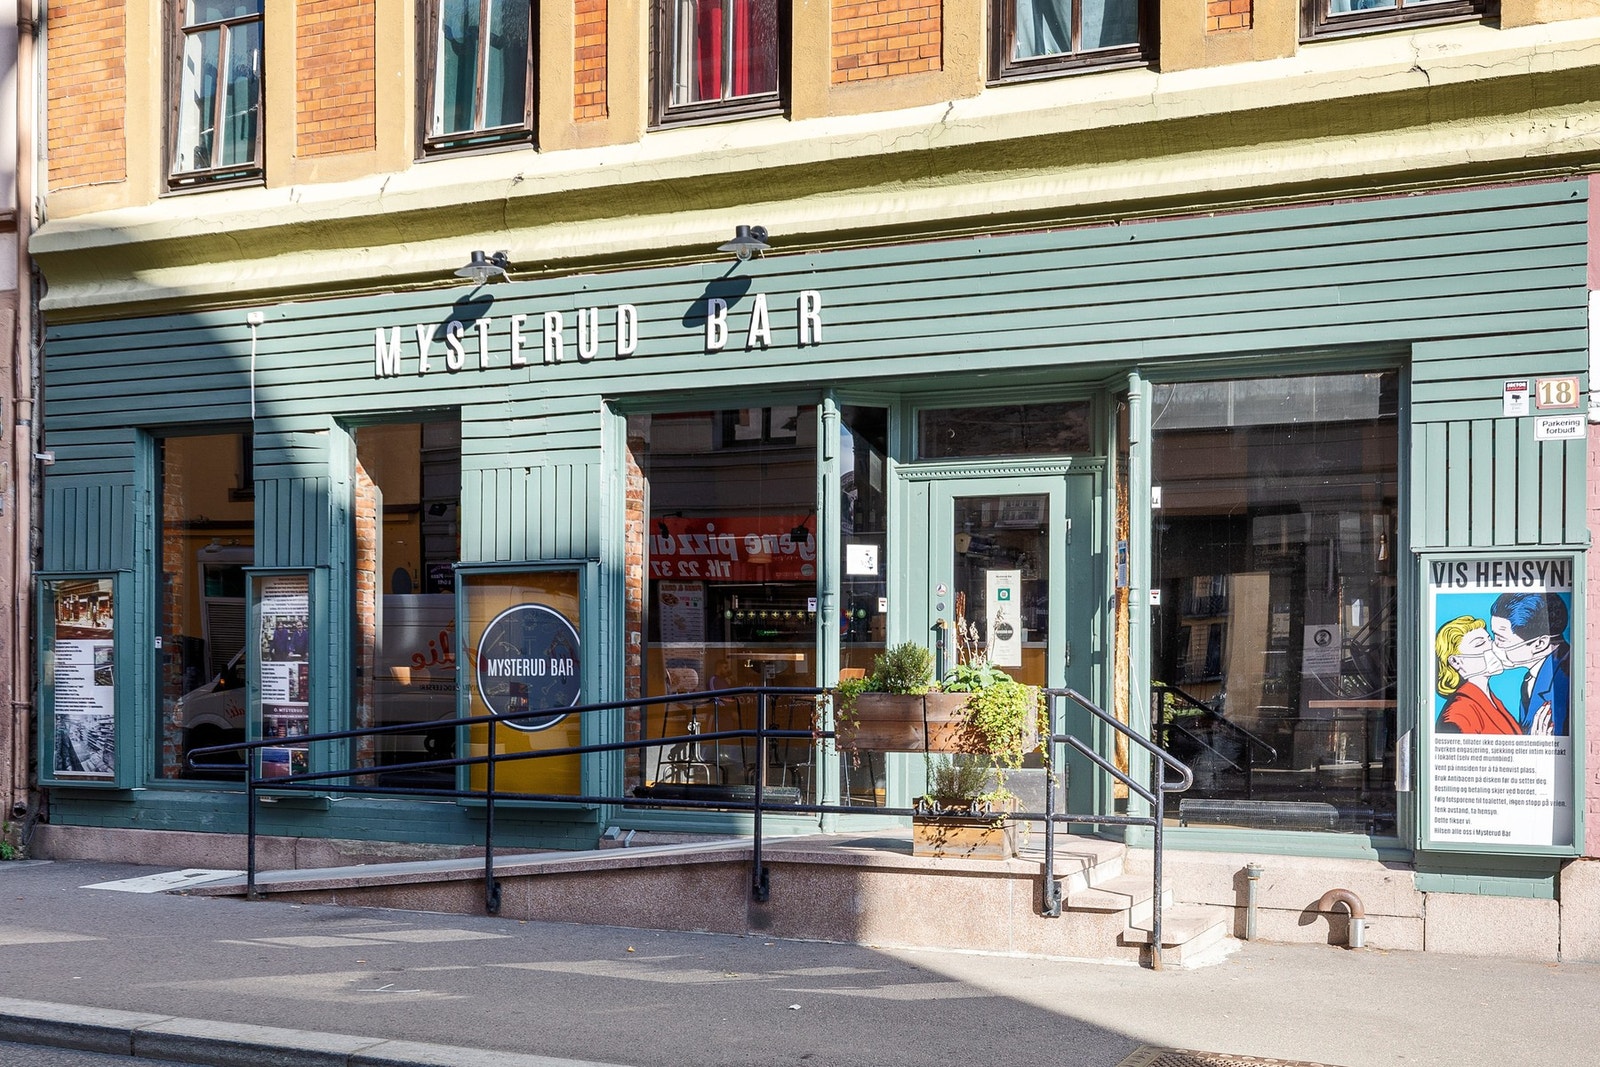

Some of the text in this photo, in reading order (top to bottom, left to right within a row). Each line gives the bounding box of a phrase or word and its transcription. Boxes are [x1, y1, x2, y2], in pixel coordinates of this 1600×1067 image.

[375, 290, 822, 377] MYSTERUD BAR
[1541, 382, 1572, 405] 18
[1432, 560, 1572, 588] VIS HENSYN!
[487, 658, 574, 677] MYSTERUD BAR
